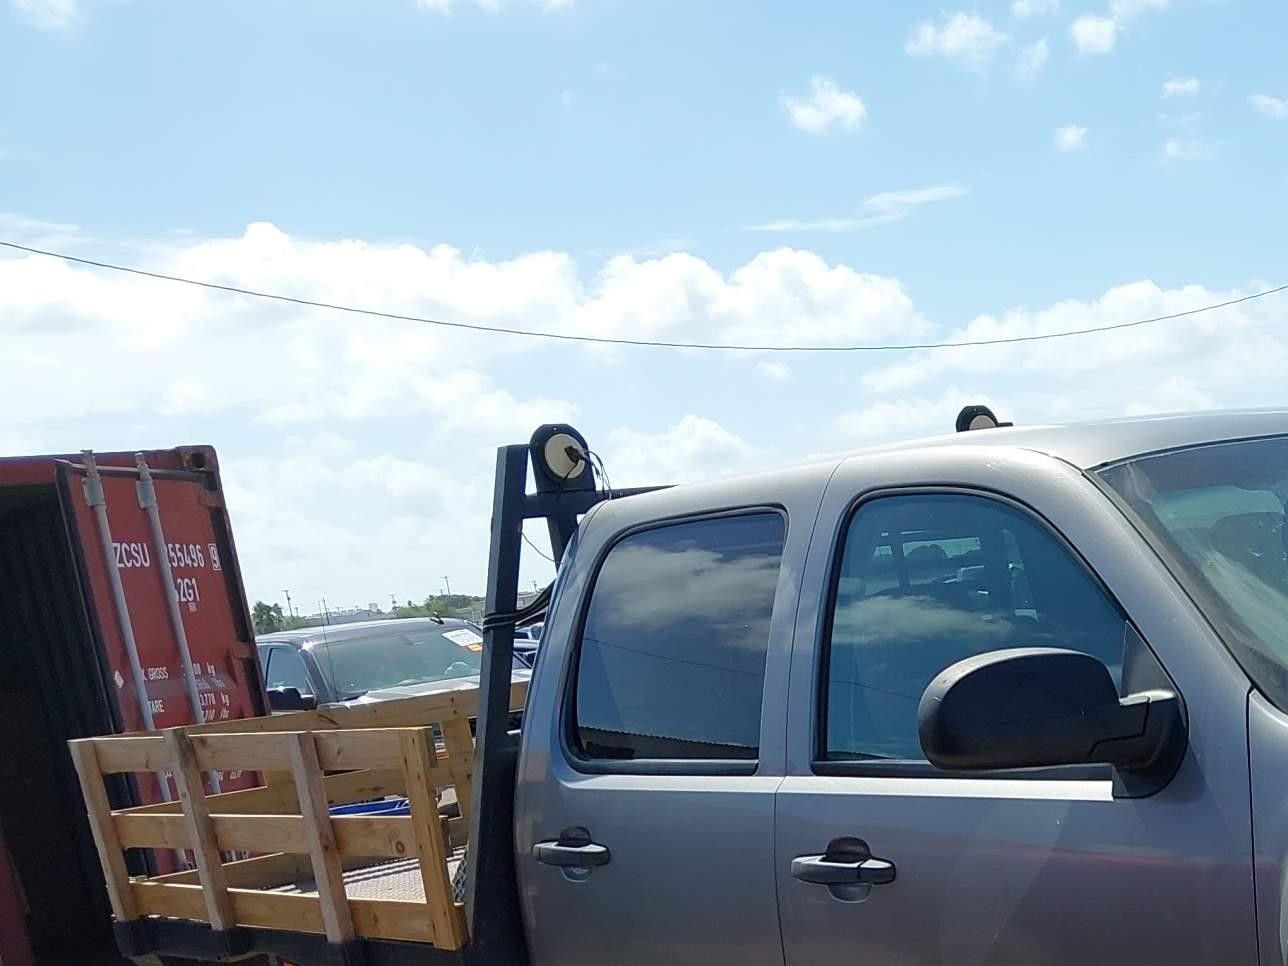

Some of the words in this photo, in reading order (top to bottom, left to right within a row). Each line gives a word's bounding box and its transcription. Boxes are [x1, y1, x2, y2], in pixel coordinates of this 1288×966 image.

[111, 542, 150, 568] ZCSU
[166, 543, 204, 568] 55496
[209, 544, 221, 570] 9
